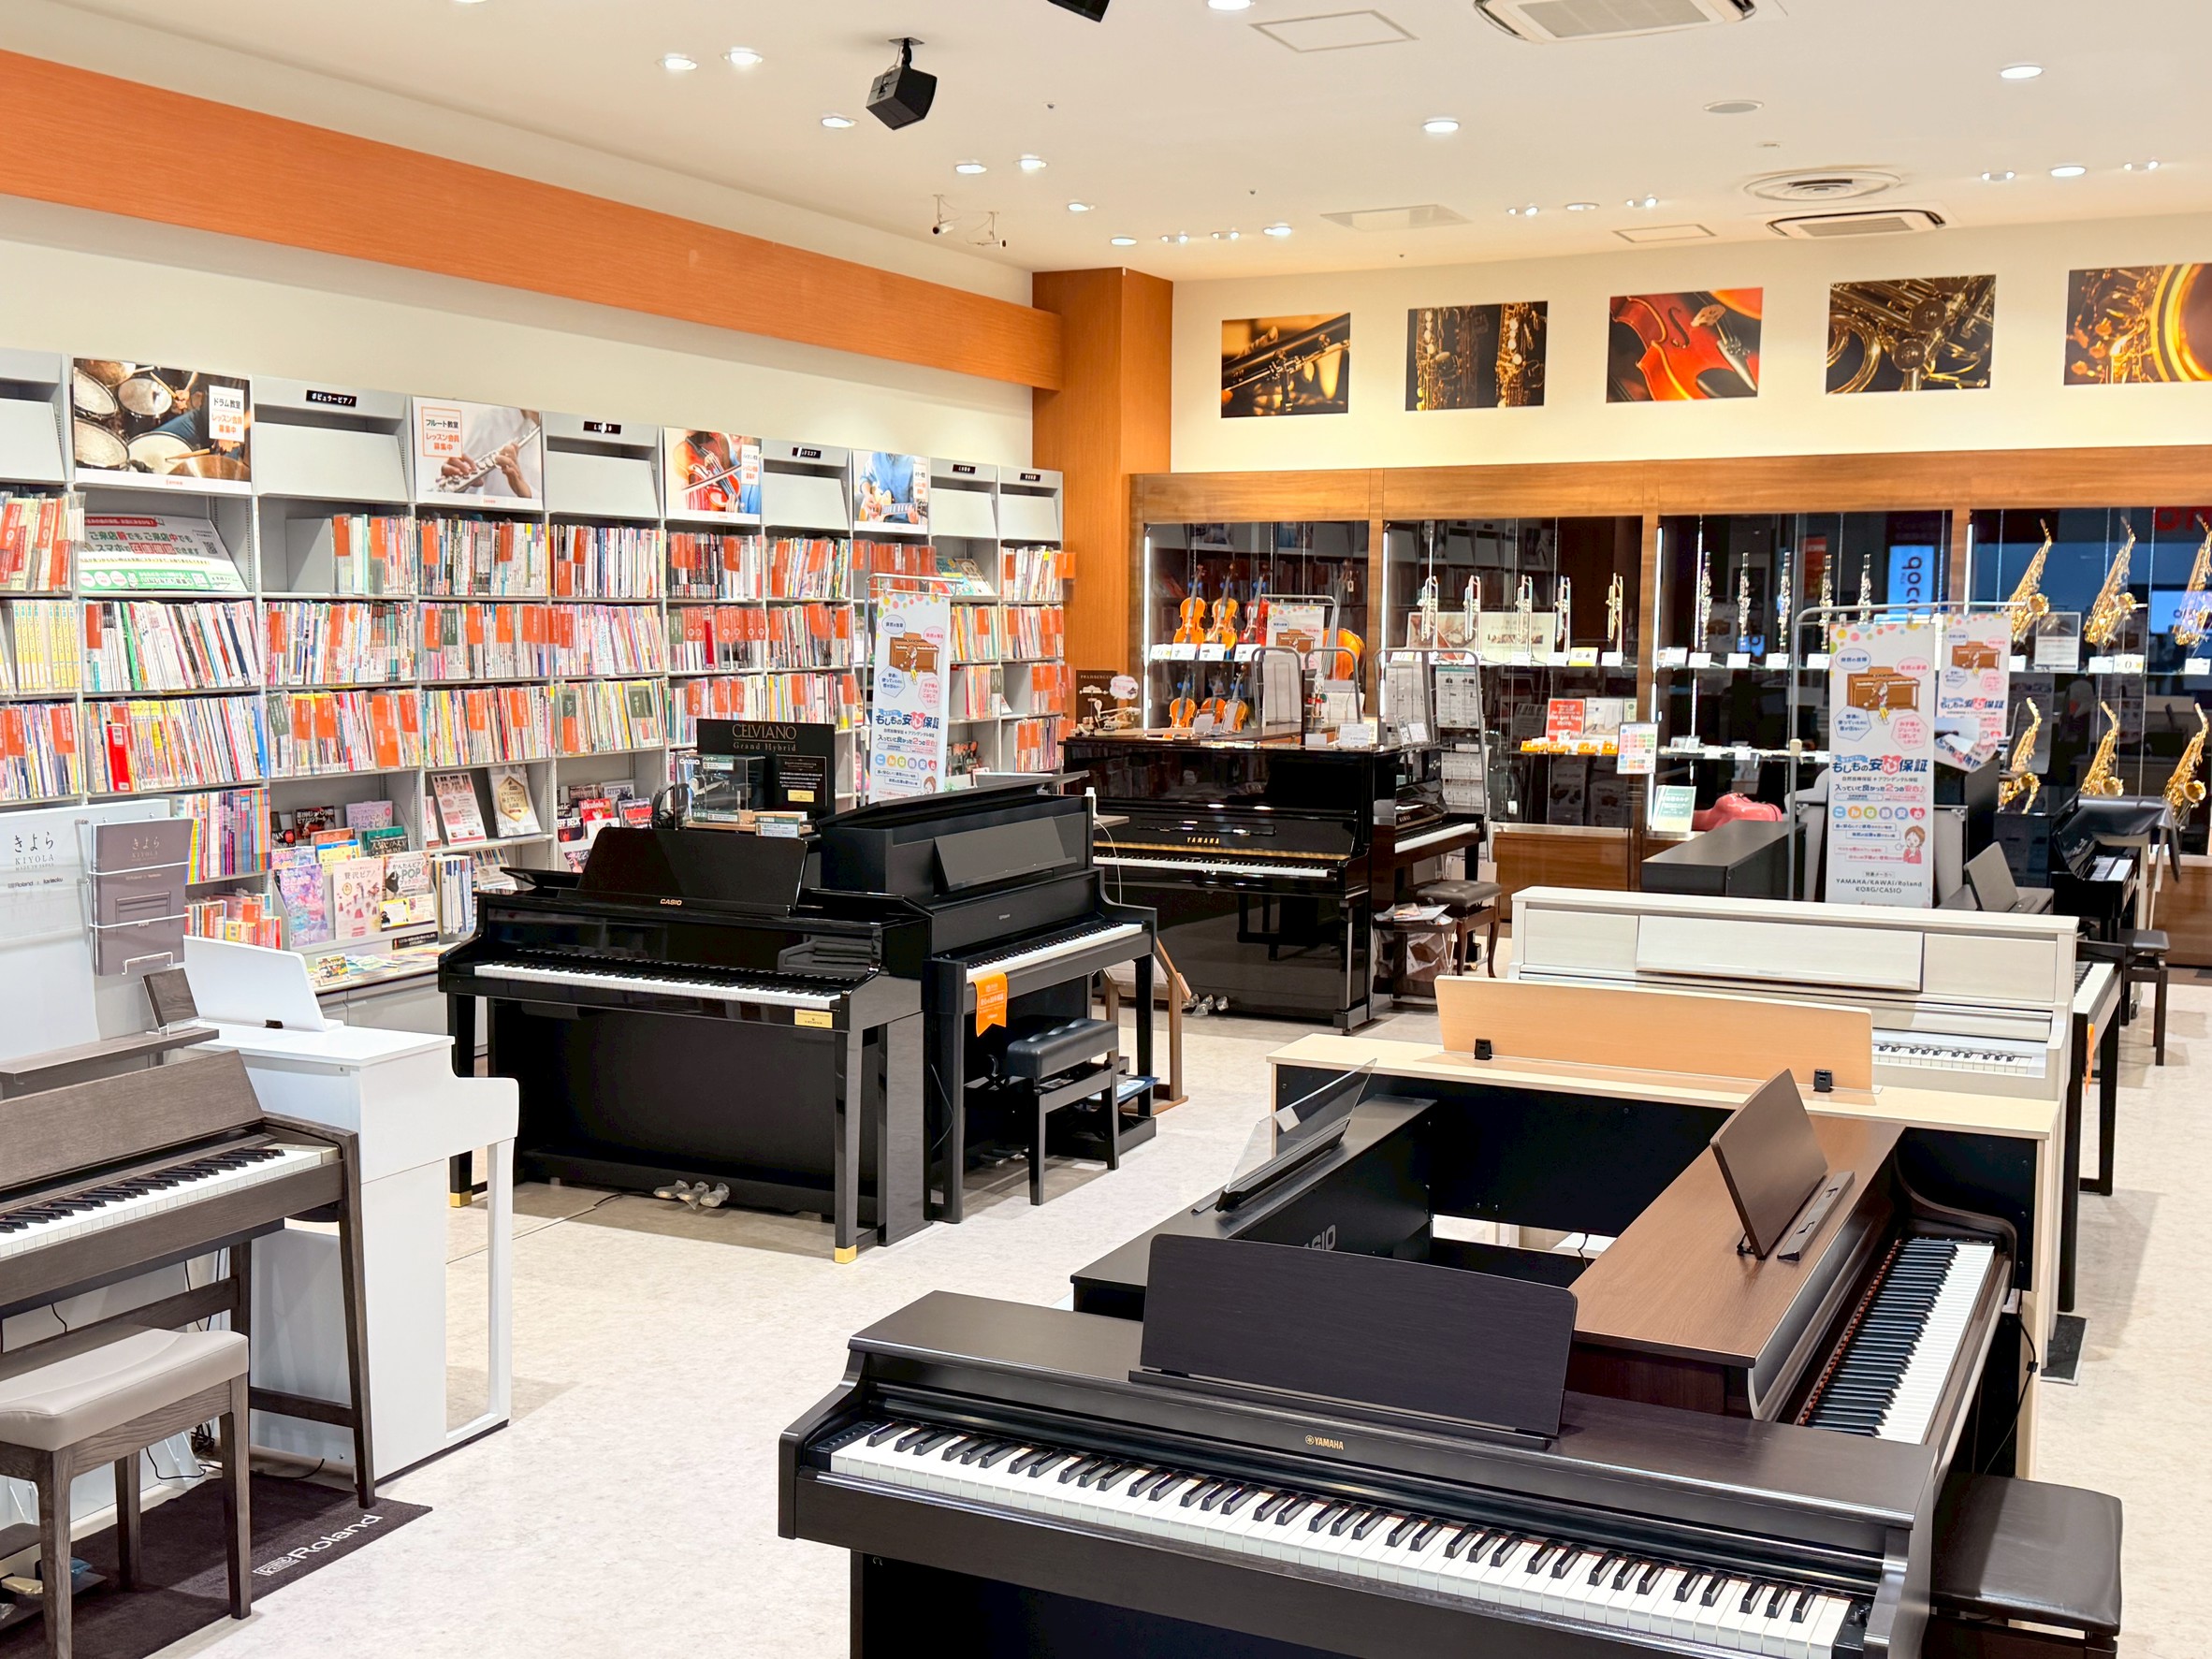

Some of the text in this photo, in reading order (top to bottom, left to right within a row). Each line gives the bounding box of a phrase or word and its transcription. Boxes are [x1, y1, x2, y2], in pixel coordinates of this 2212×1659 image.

[213, 397, 241, 410] ドラム教室
[212, 413, 242, 425] レッスン会員
[426, 419, 458, 429] フルート教室
[218, 424, 236, 434] 募集中
[426, 432, 459, 442] レッスン会員
[91, 531, 193, 543] ご来店前でも ご来店中でも
[96, 543, 200, 555] スマホで在庫確認できます
[875, 713, 939, 729] もしもの安心保証
[732, 724, 797, 740] CELVIANO
[765, 744, 796, 752] Hybrid
[1833, 758, 1928, 774] もしもの安心保証
[15, 831, 54, 853] きよら
[132, 836, 160, 850] きよら
[15, 854, 54, 866] KIYOLA
[1836, 878, 1922, 887] YAMAHA/KAWAI/Roland
[1314, 1436, 1344, 1451] YAMAHA
[287, 1514, 384, 1559] Roland
